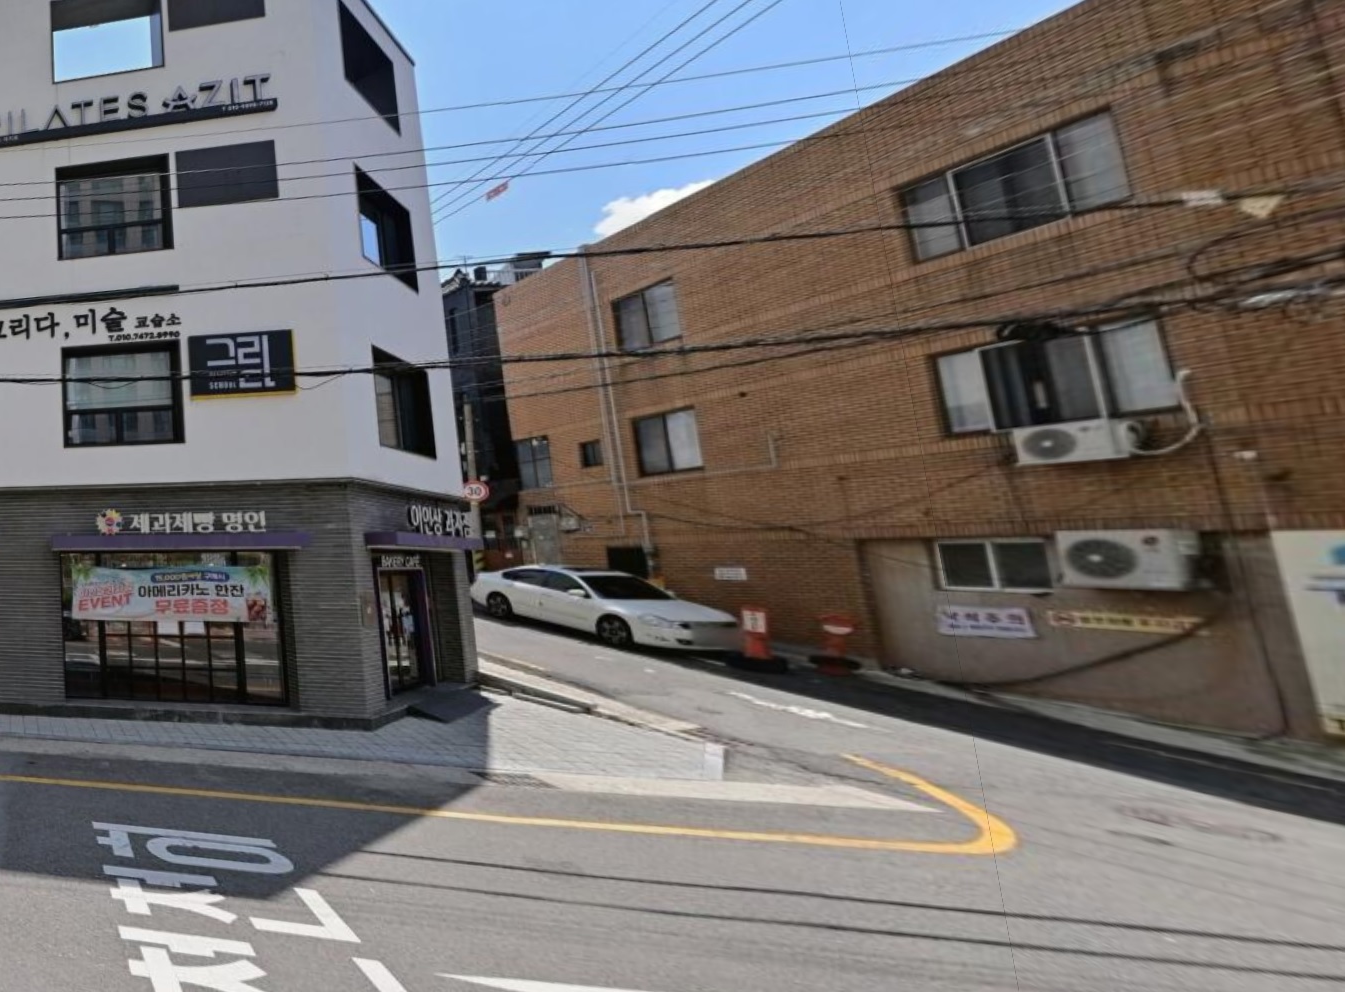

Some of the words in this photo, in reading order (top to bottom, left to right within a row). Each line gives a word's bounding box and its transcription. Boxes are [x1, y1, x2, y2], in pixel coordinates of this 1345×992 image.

[73, 306, 127, 335] 미술
[134, 313, 182, 329] 교습소
[466, 486, 482, 496] 30
[130, 511, 215, 534] 제과제빵
[222, 510, 267, 533] 명인
[137, 583, 210, 598] 아메리카노
[214, 583, 245, 598] 한잔
[78, 592, 134, 611] EVENT
[154, 598, 229, 615] 무료증정
